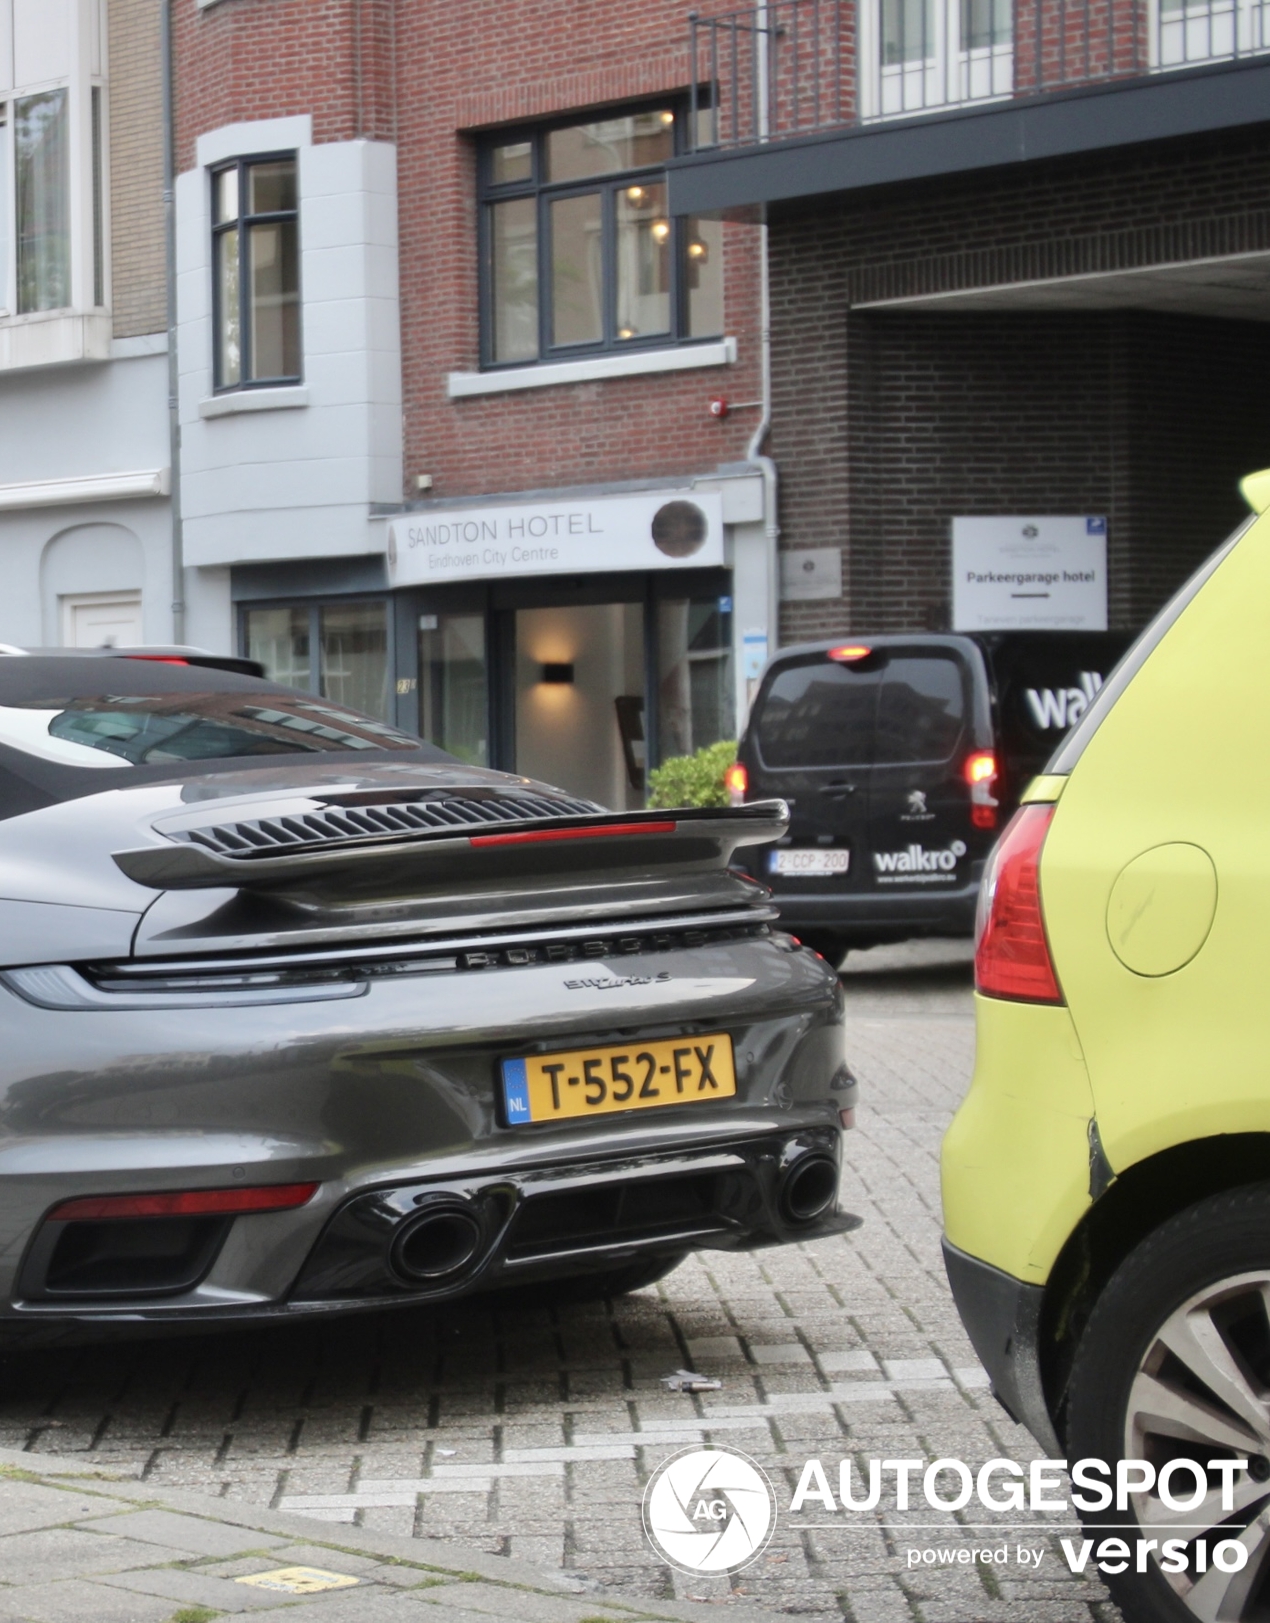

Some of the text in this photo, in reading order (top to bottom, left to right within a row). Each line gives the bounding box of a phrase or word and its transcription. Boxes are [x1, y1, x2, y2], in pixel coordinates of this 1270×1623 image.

[408, 512, 604, 549] SANDTON HOTEL
[429, 546, 559, 569] Eindhoven City Centre
[966, 570, 1096, 586] Parkeergarage hotel
[874, 843, 957, 872] walkro
[541, 1044, 719, 1110] T-552-FX
[509, 1097, 527, 1113] NL
